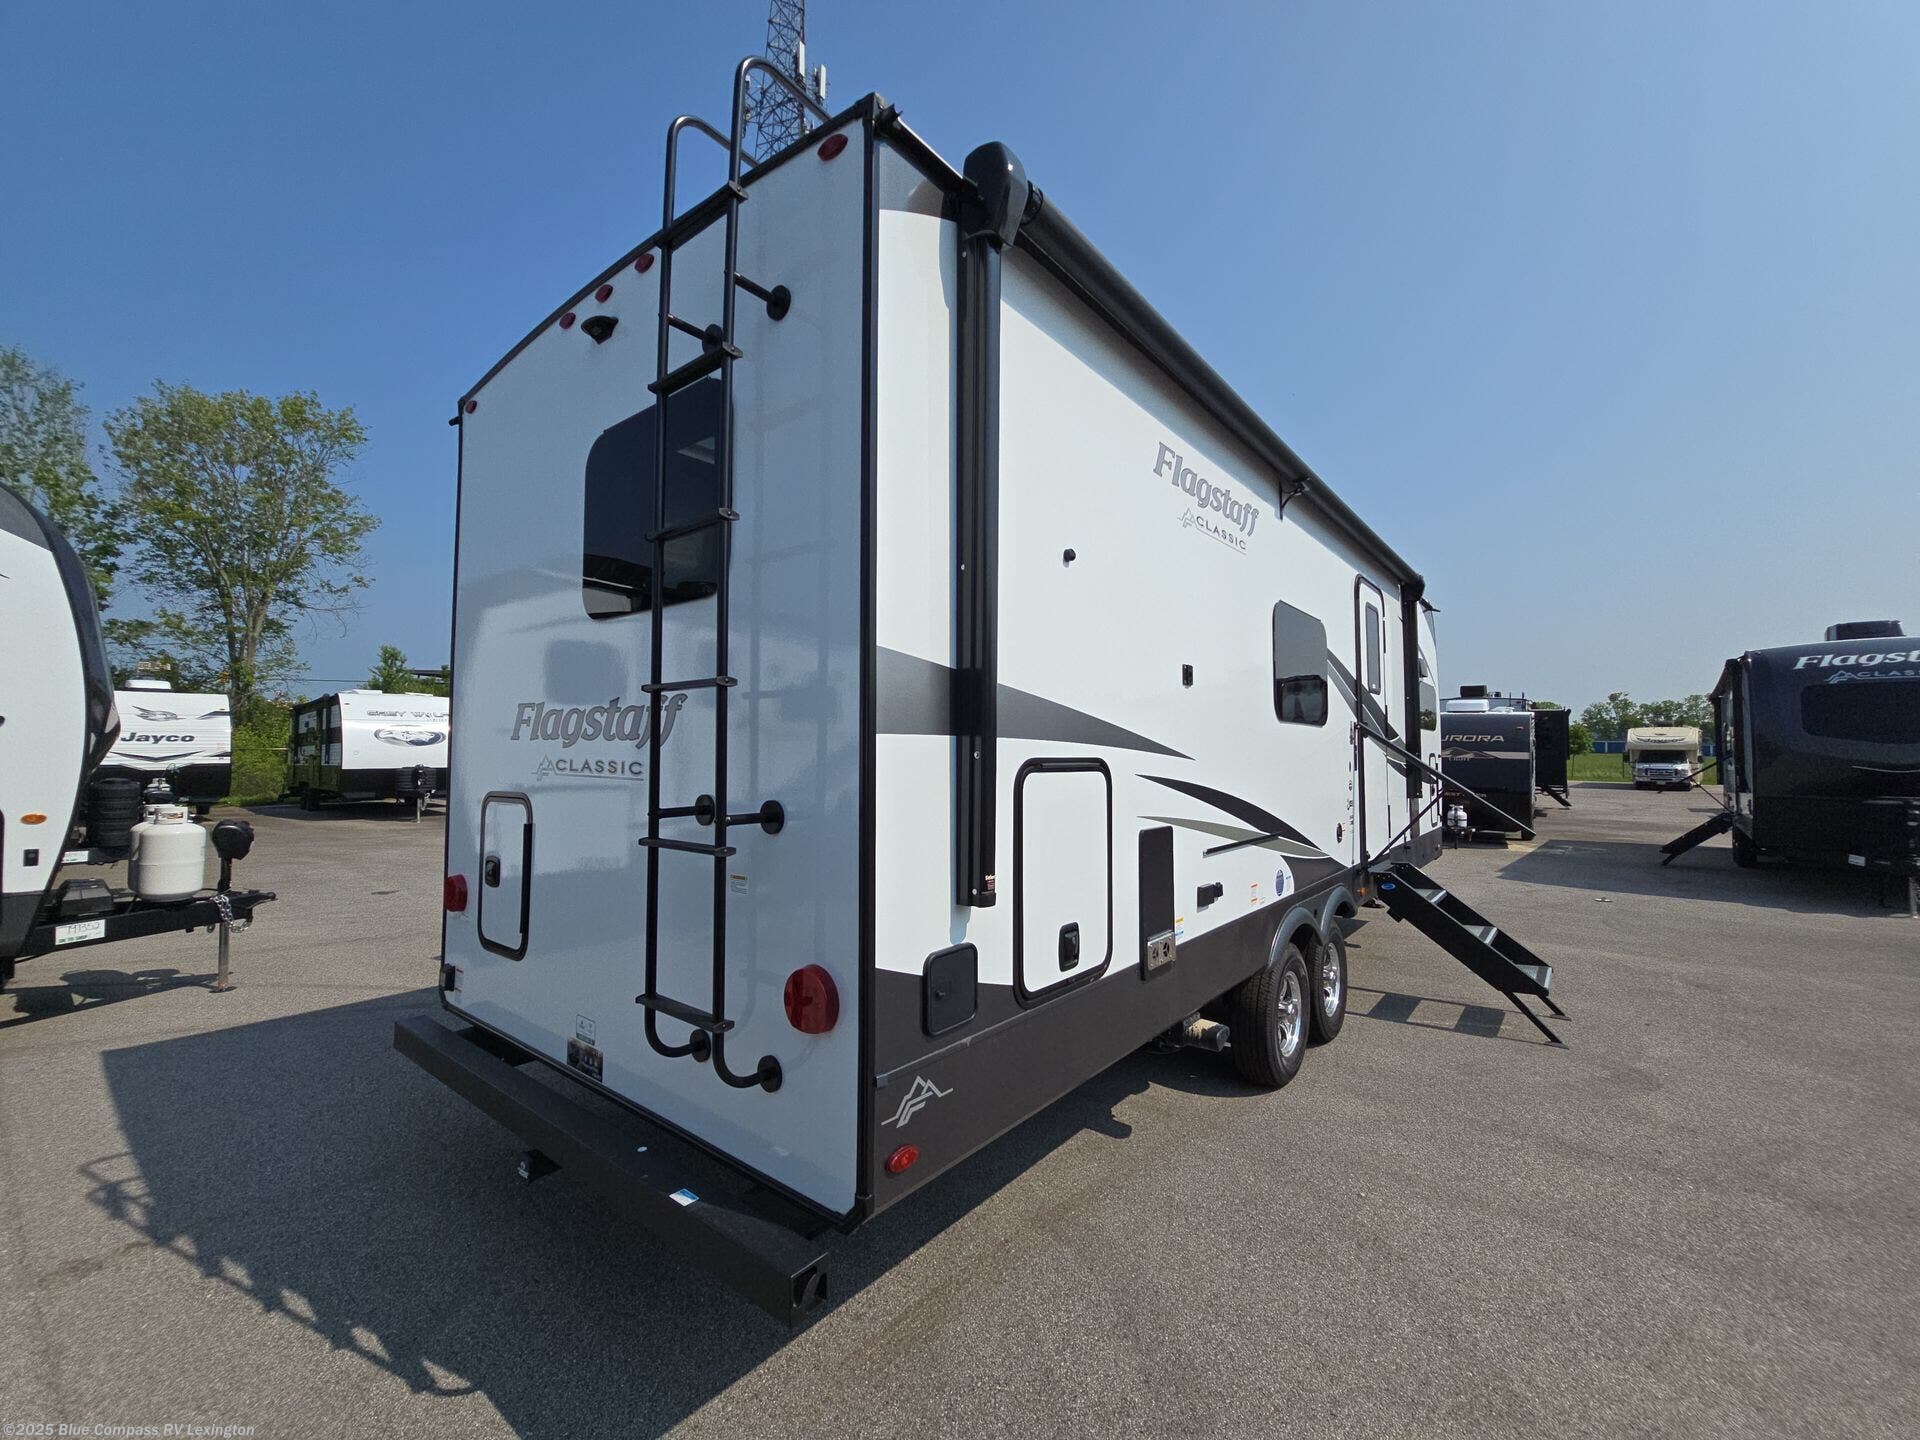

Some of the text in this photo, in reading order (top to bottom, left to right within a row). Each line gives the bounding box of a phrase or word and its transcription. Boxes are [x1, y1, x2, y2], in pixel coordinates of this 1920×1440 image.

[1153, 441, 1260, 537] Flagstaff
[1196, 515, 1247, 550] CLASSIC
[120, 731, 195, 745] Jayco
[510, 693, 688, 749] Flagstaff
[555, 759, 644, 775] CLASSIC
